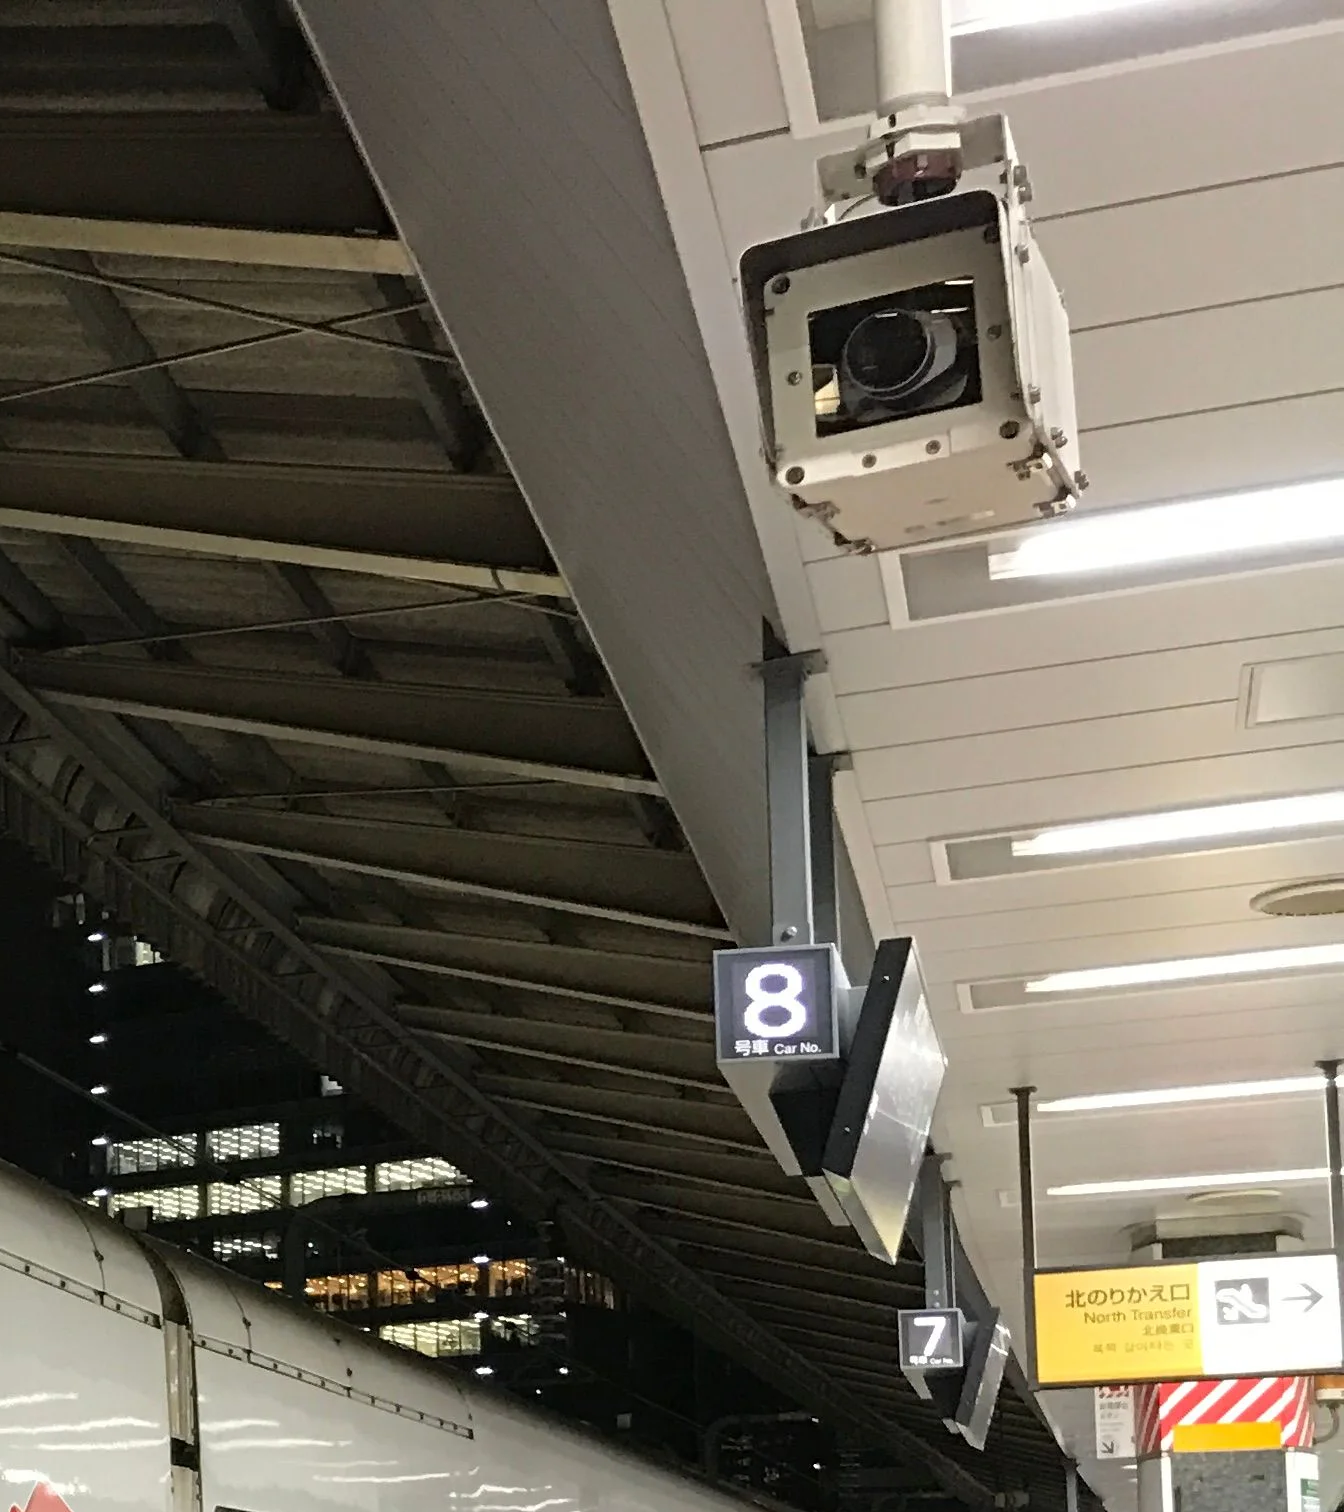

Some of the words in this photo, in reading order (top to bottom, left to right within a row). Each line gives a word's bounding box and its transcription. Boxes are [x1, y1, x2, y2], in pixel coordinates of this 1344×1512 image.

[743, 963, 807, 1038] 8
[734, 1039, 769, 1056] 号車
[773, 1043, 797, 1055] Car
[800, 1042, 822, 1053] No.
[1065, 1283, 1190, 1309] 北のりかえ口
[1083, 1310, 1127, 1324] North
[1131, 1307, 1192, 1321] Transfer
[913, 1316, 947, 1357] 7
